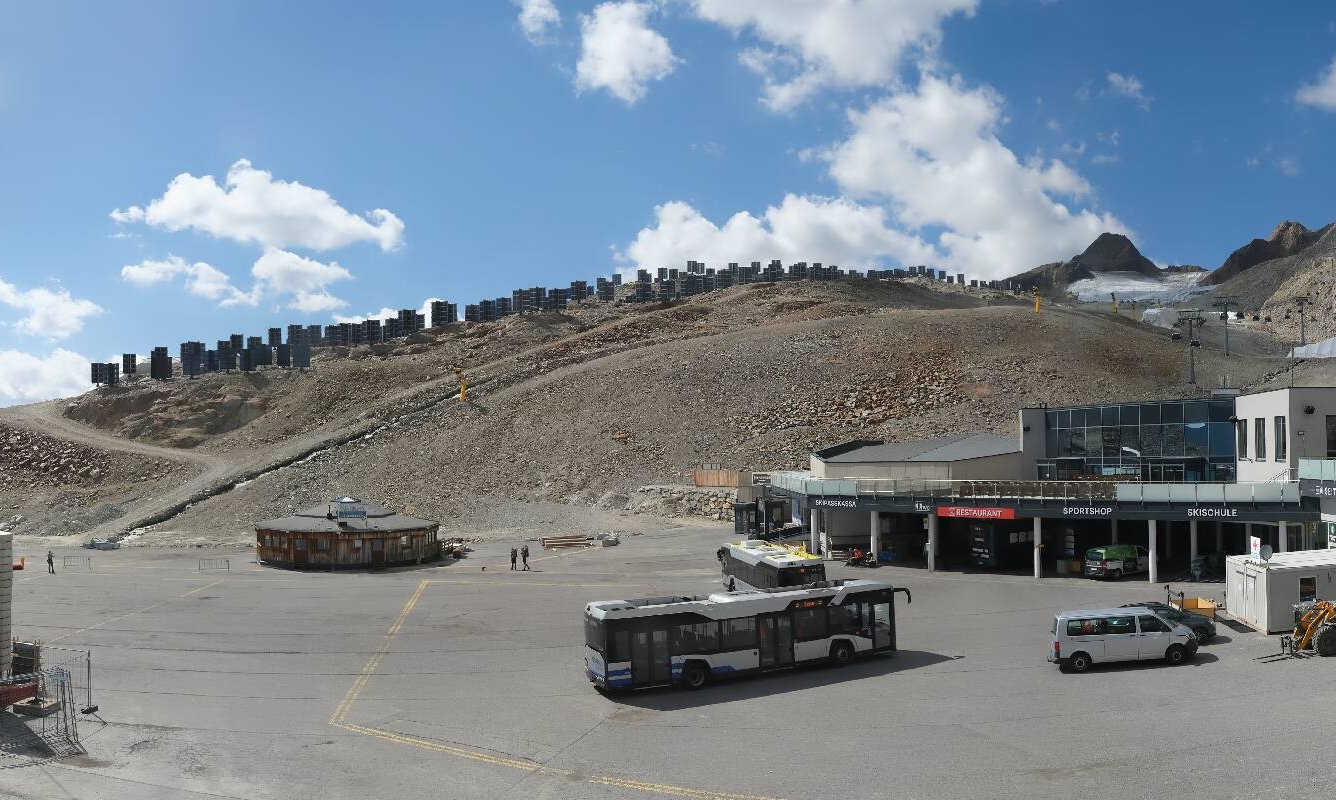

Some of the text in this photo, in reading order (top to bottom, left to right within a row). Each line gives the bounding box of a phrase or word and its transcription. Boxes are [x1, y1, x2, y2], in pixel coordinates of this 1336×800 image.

[956, 508, 1003, 518] RESTAURANT
[1063, 507, 1112, 515] SPORTSHOP
[1187, 508, 1238, 517] SKISCHULE
